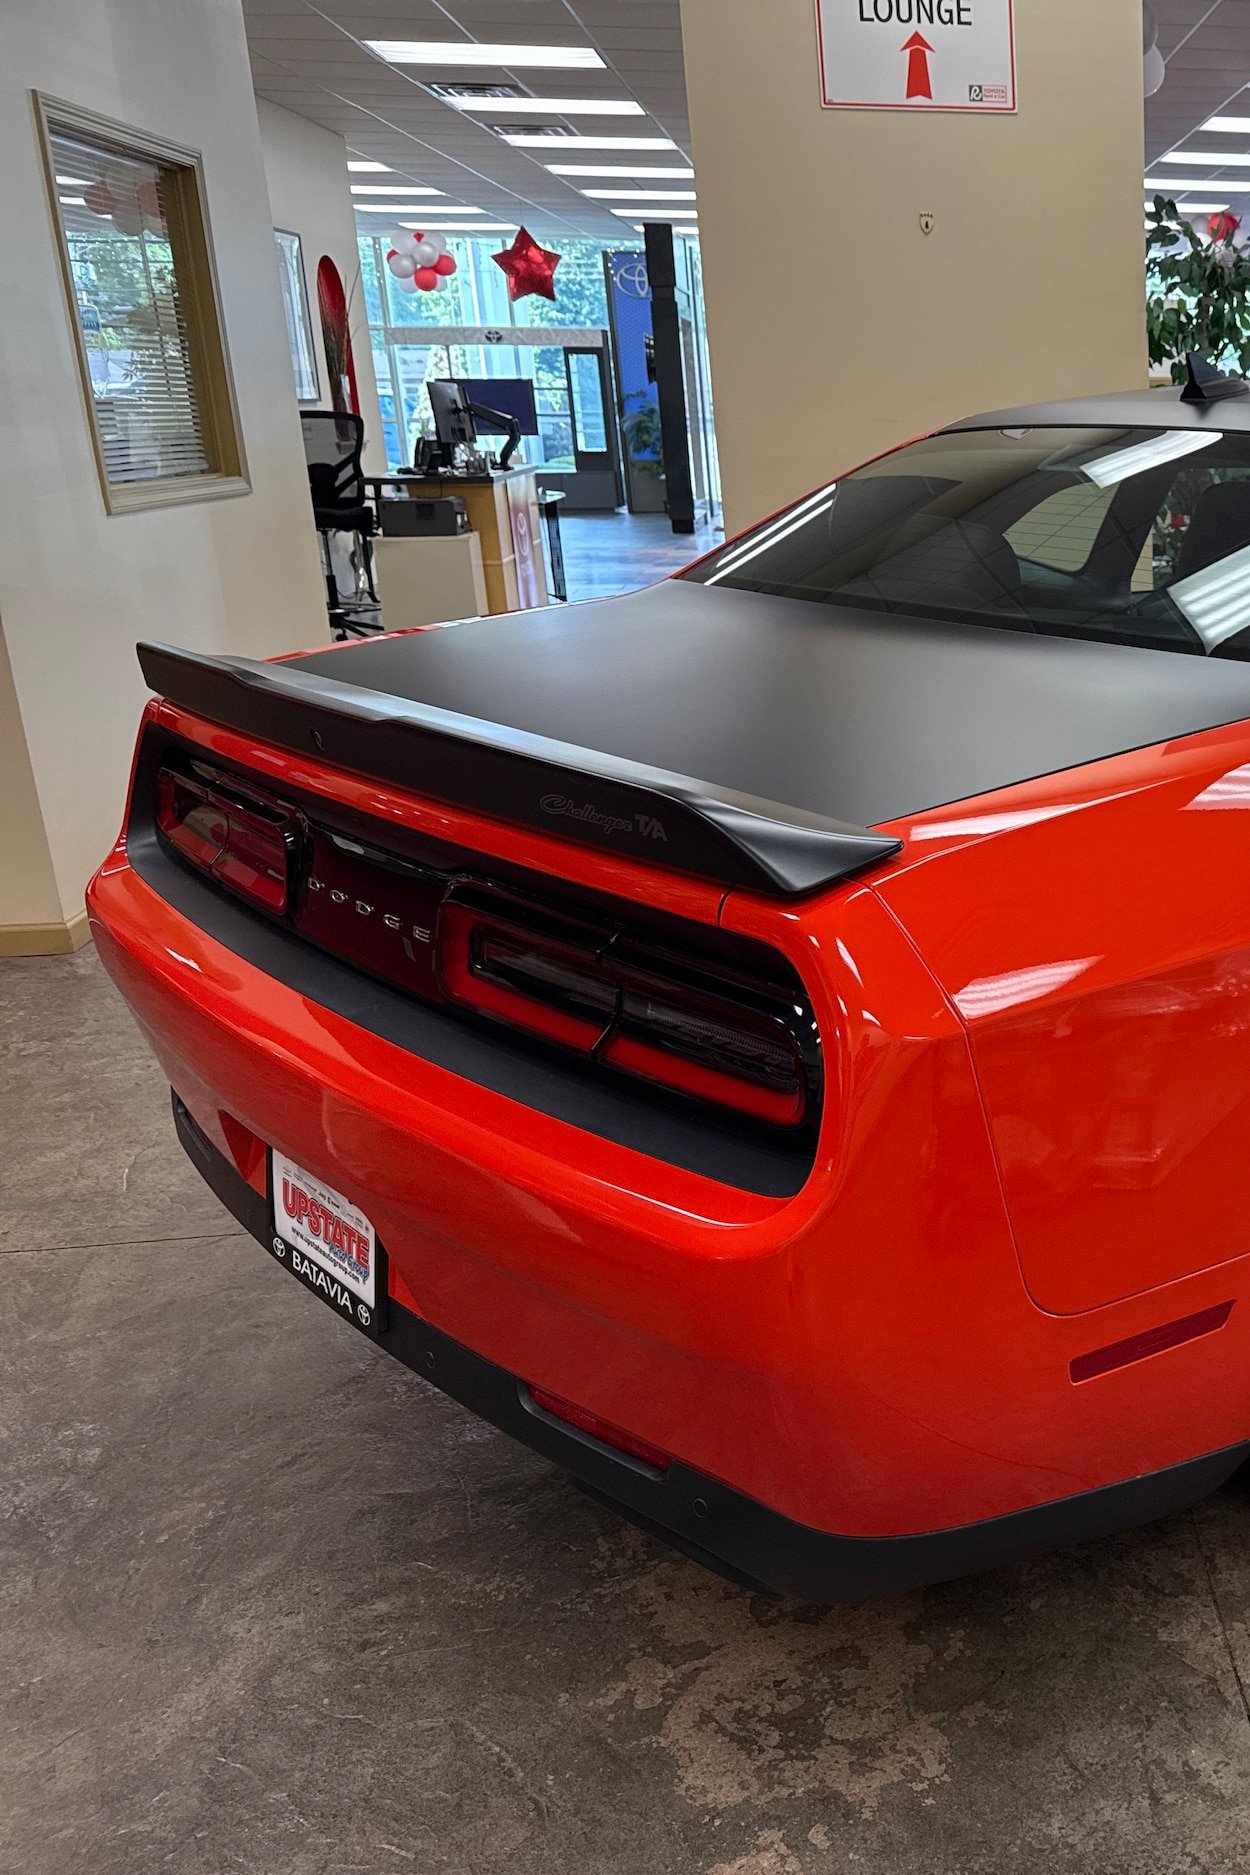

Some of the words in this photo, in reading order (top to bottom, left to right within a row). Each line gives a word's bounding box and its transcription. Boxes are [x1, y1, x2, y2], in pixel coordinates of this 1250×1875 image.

[859, 0, 972, 25] LOUNGE
[540, 794, 633, 834] Challenger
[307, 877, 431, 943] DODGE
[282, 1178, 370, 1270] UPSTATE
[292, 1250, 353, 1315] BATAVIA
